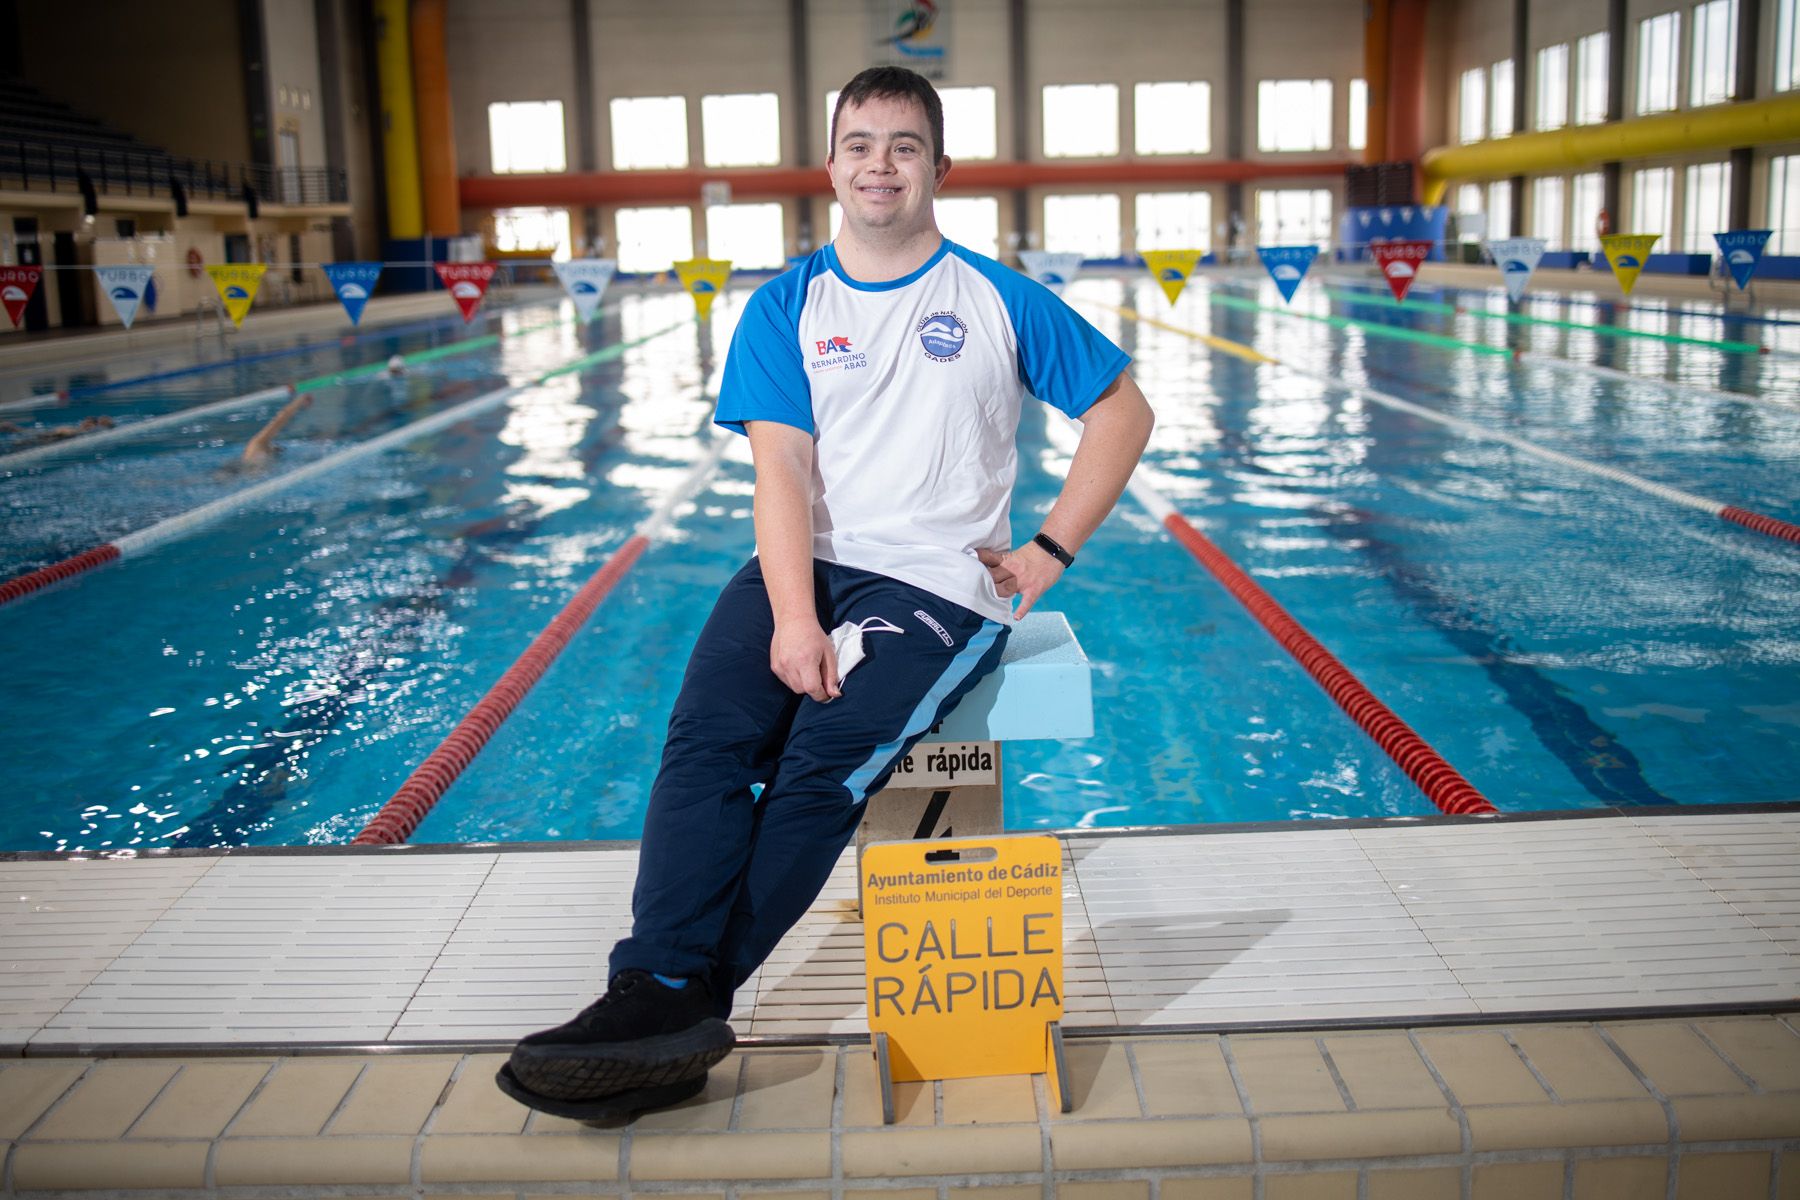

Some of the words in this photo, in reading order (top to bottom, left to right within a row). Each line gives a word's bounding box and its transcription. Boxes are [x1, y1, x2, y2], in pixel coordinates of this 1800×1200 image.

[1376, 245, 1427, 259] TURBO
[0, 270, 39, 282] URBO
[98, 270, 149, 282] TURBO
[327, 268, 379, 281] TURBO
[438, 265, 494, 280] TURBO
[917, 316, 930, 332] CLUB
[811, 352, 865, 369] BERNARDINO
[924, 352, 961, 362] GADES
[844, 360, 867, 370] ABAD
[927, 745, 992, 780] rápida
[867, 867, 983, 890] Ayuntamiento
[988, 866, 1008, 880] de
[1011, 863, 1059, 880] Cádiz
[875, 893, 921, 906] Instituto
[925, 888, 980, 904] Municipal
[984, 887, 1002, 899] del
[1007, 885, 1053, 900] Deporte
[878, 912, 1054, 963] CALLE
[874, 963, 1060, 1017] RÁPIDA
